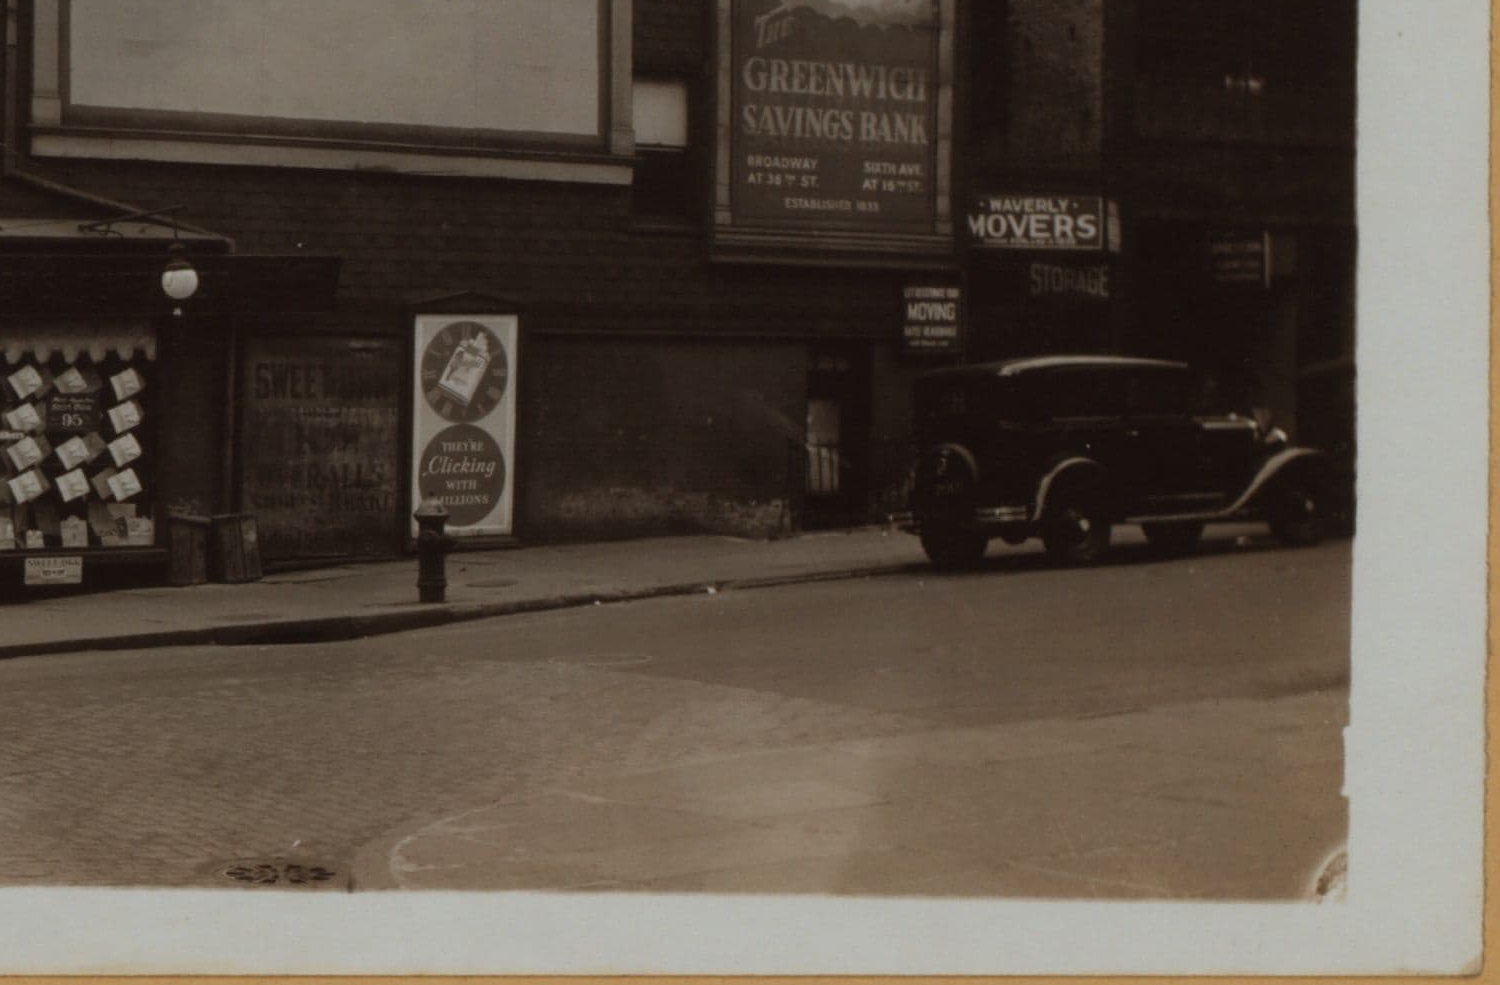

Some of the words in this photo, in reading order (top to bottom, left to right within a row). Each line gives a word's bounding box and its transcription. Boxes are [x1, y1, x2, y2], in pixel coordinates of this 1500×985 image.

[741, 55, 928, 103] GREENWICH
[742, 103, 854, 142] SAVINGS
[859, 111, 929, 145] BANK
[747, 154, 819, 169] BROADWAY
[862, 160, 897, 175] SIXTH
[747, 172, 763, 185] AT
[862, 177, 880, 191] AT
[783, 197, 852, 211] ESTABLISHED
[989, 197, 1071, 214] WAVERLY
[966, 213, 1098, 240] MOVERS
[1029, 262, 1111, 299] STORAGE
[906, 302, 957, 321] MOVING
[441, 441, 485, 453] THEY'RE
[425, 455, 496, 478] Clicking
[444, 479, 478, 491] WITH
